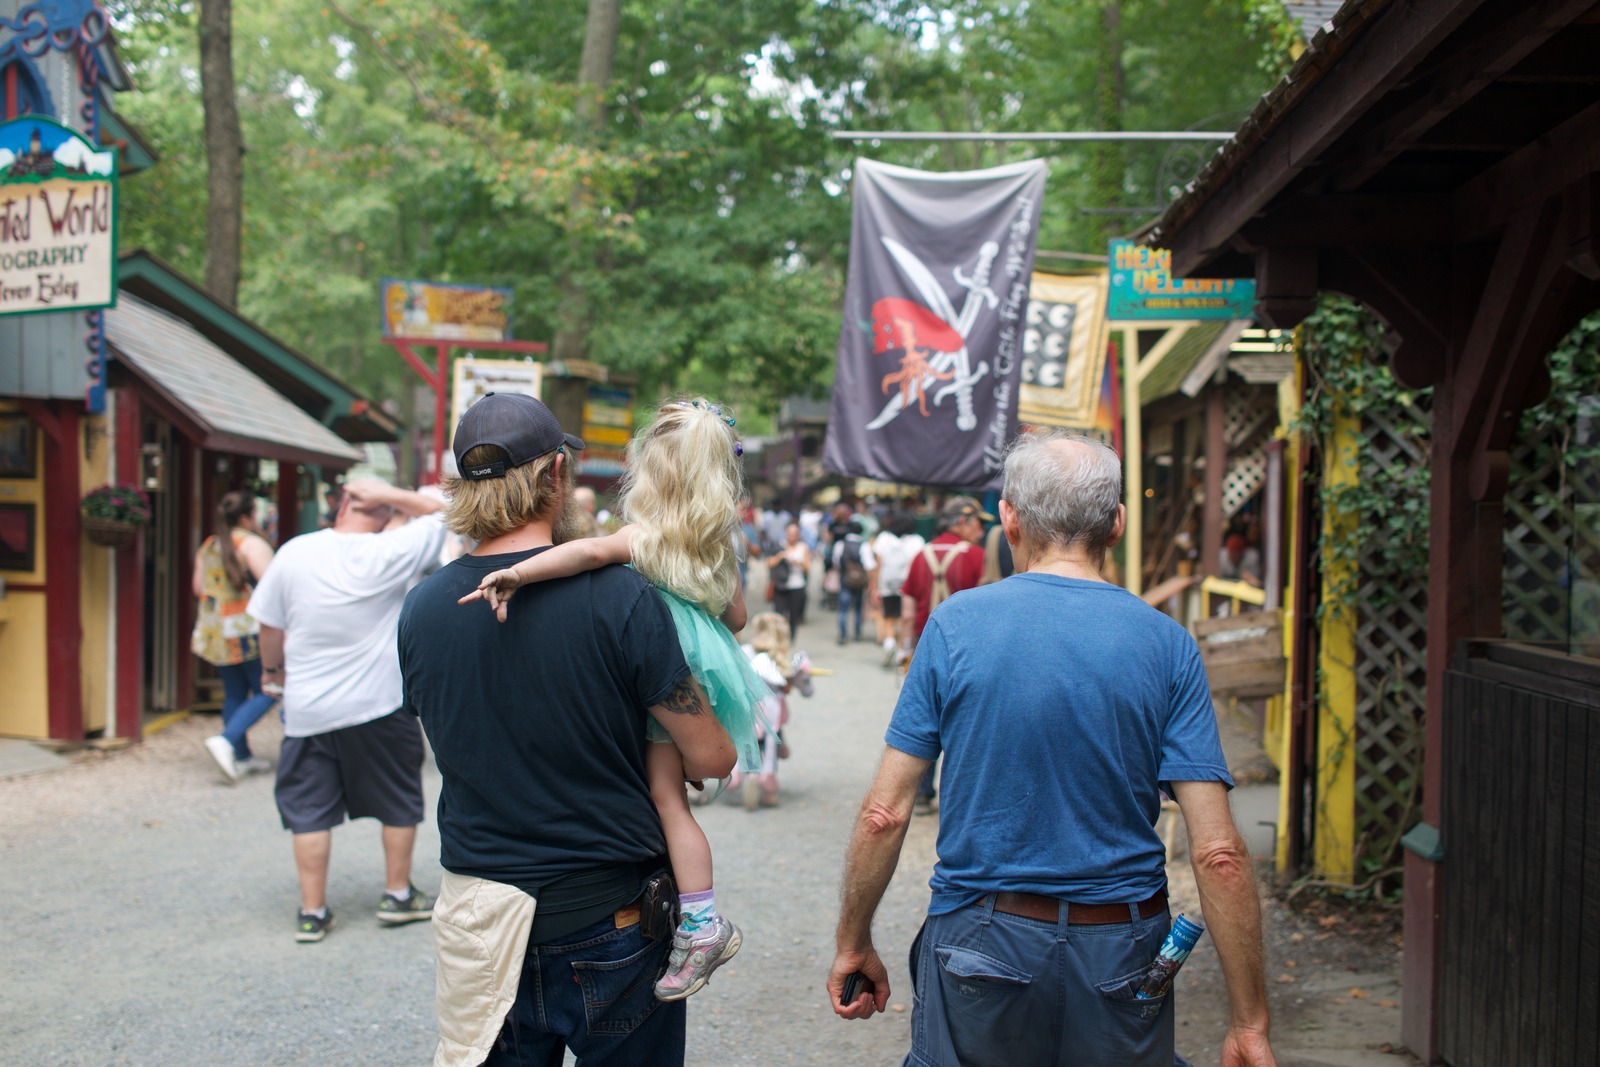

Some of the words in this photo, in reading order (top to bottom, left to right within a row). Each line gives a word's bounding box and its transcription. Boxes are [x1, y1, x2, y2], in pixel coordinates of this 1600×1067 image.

[40, 186, 108, 236] World
[1009, 195, 1034, 239] Sail
[0, 244, 88, 272] OGRAPHY
[1000, 282, 1028, 320] Flag
[993, 381, 1011, 410] the
[984, 410, 1007, 474] Under
[1174, 927, 1195, 945] TRAVEL
